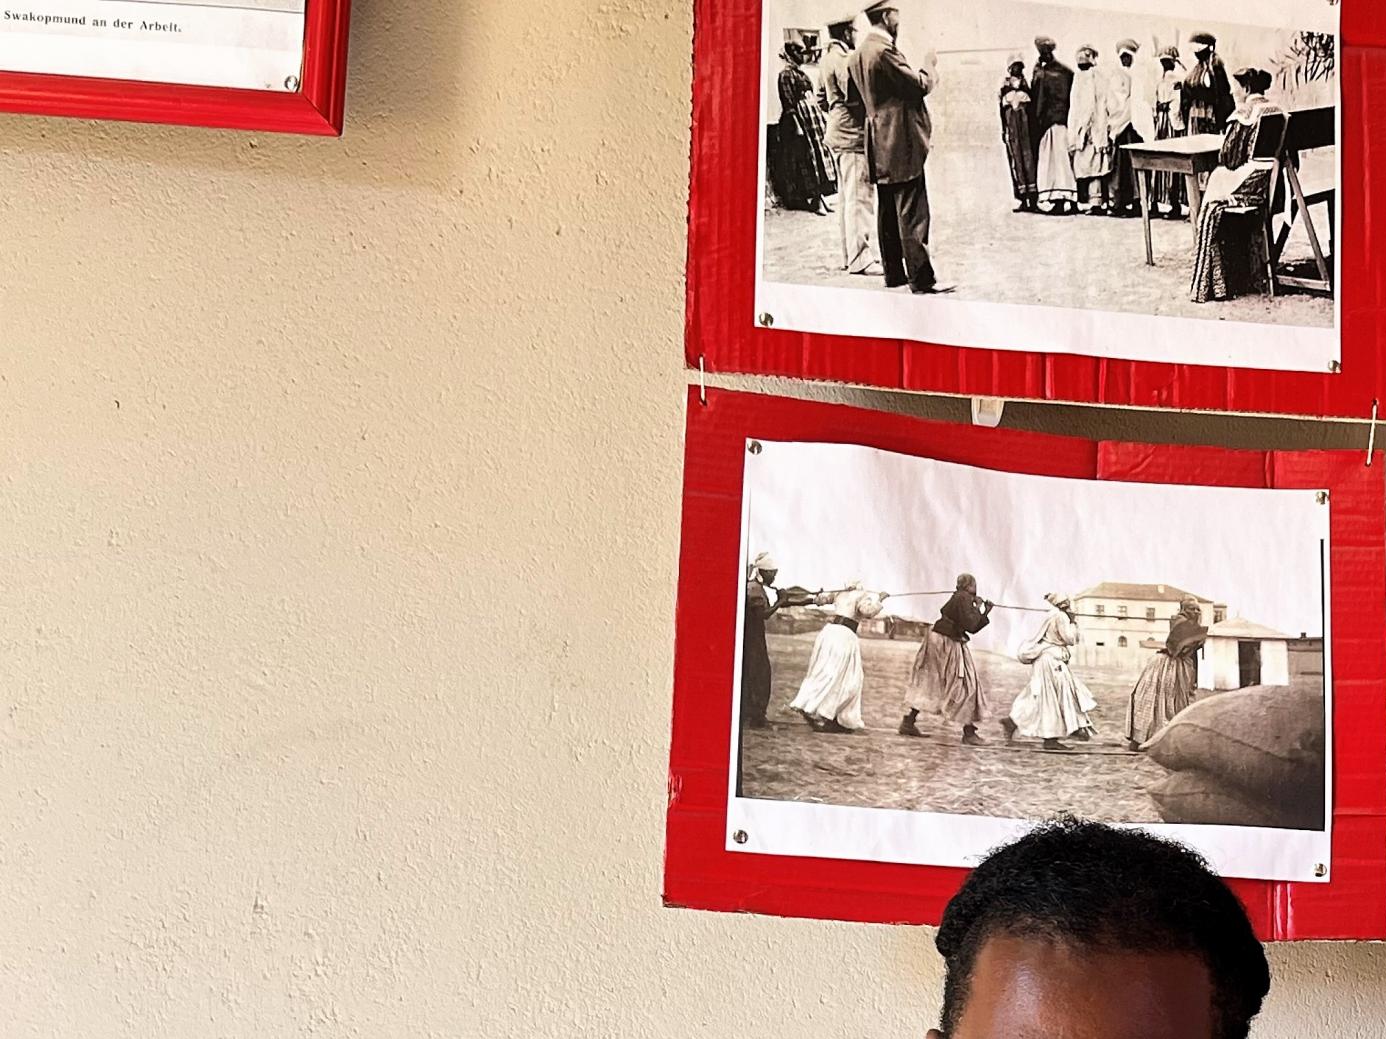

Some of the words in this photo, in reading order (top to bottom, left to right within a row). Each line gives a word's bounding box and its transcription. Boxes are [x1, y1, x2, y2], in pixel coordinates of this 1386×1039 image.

[4, 10, 86, 25] Swakopmund
[92, 17, 107, 27] an
[113, 18, 133, 29] der
[140, 21, 182, 33] Arbeit.
